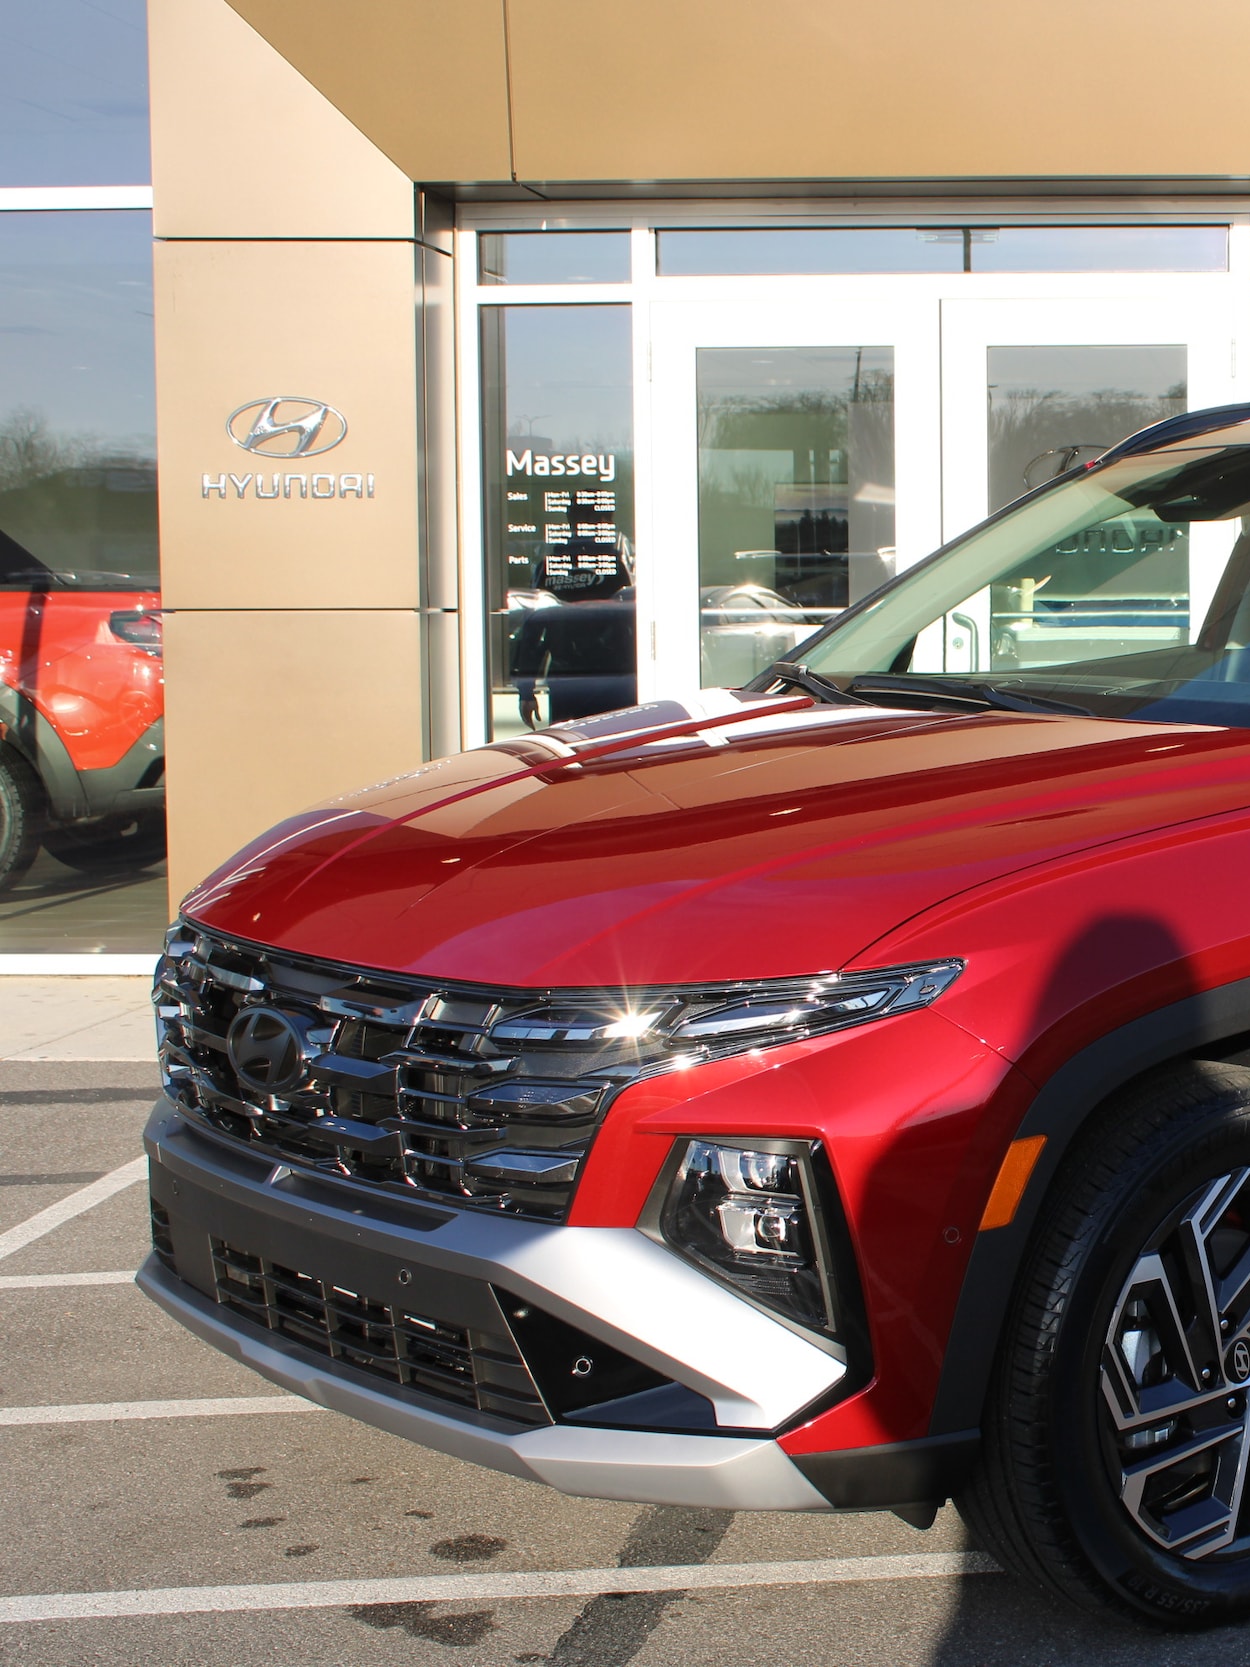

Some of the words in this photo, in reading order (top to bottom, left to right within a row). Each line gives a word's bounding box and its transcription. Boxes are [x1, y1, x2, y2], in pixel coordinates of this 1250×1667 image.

[506, 449, 616, 482] Massey
[202, 473, 375, 499] HYUNDAI
[507, 492, 528, 501] Sales
[593, 504, 616, 512] CLOSED
[507, 523, 537, 533] Service
[508, 555, 529, 565] Parts
